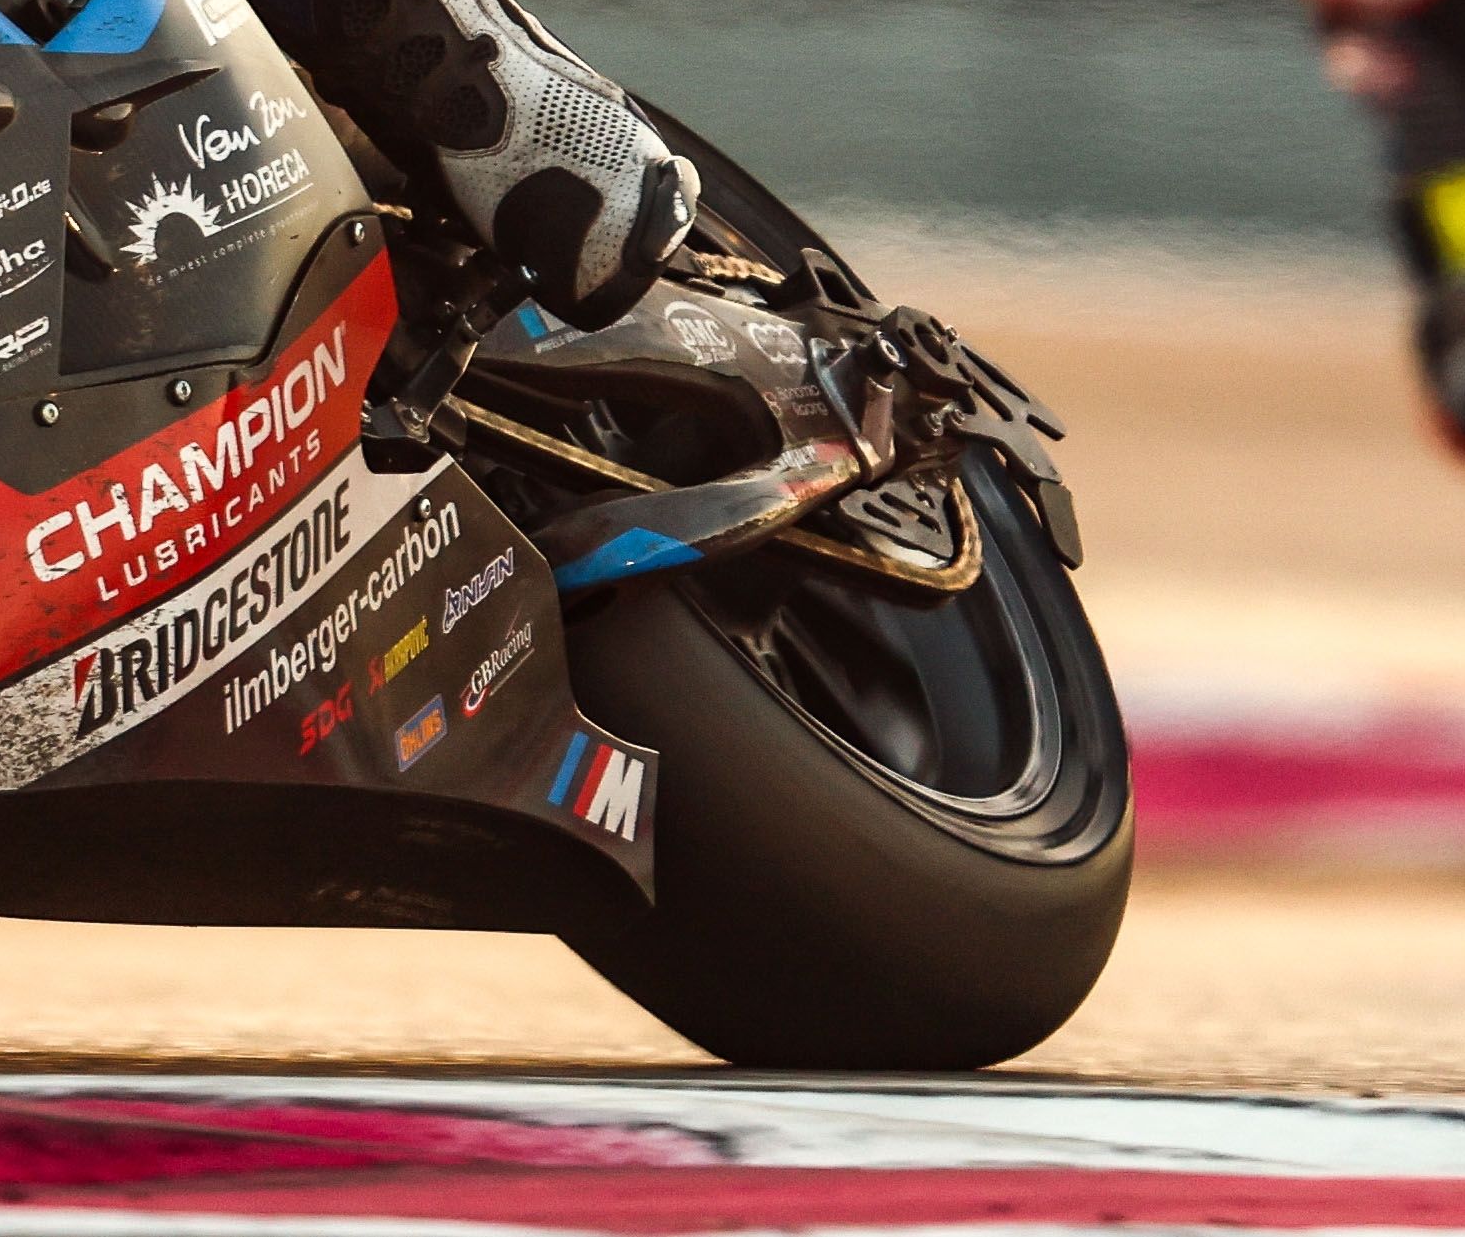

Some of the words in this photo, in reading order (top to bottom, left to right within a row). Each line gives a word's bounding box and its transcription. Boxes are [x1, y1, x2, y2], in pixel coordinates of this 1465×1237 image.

[221, 148, 311, 214] HORECA
[26, 331, 350, 582] CHAMPION
[97, 429, 322, 602] LUBRICANTS
[74, 477, 352, 741] BRIDGESTONE
[222, 500, 461, 735] ilmberger-carbon
[470, 621, 533, 695] GBRacing
[299, 679, 355, 757] SDG
